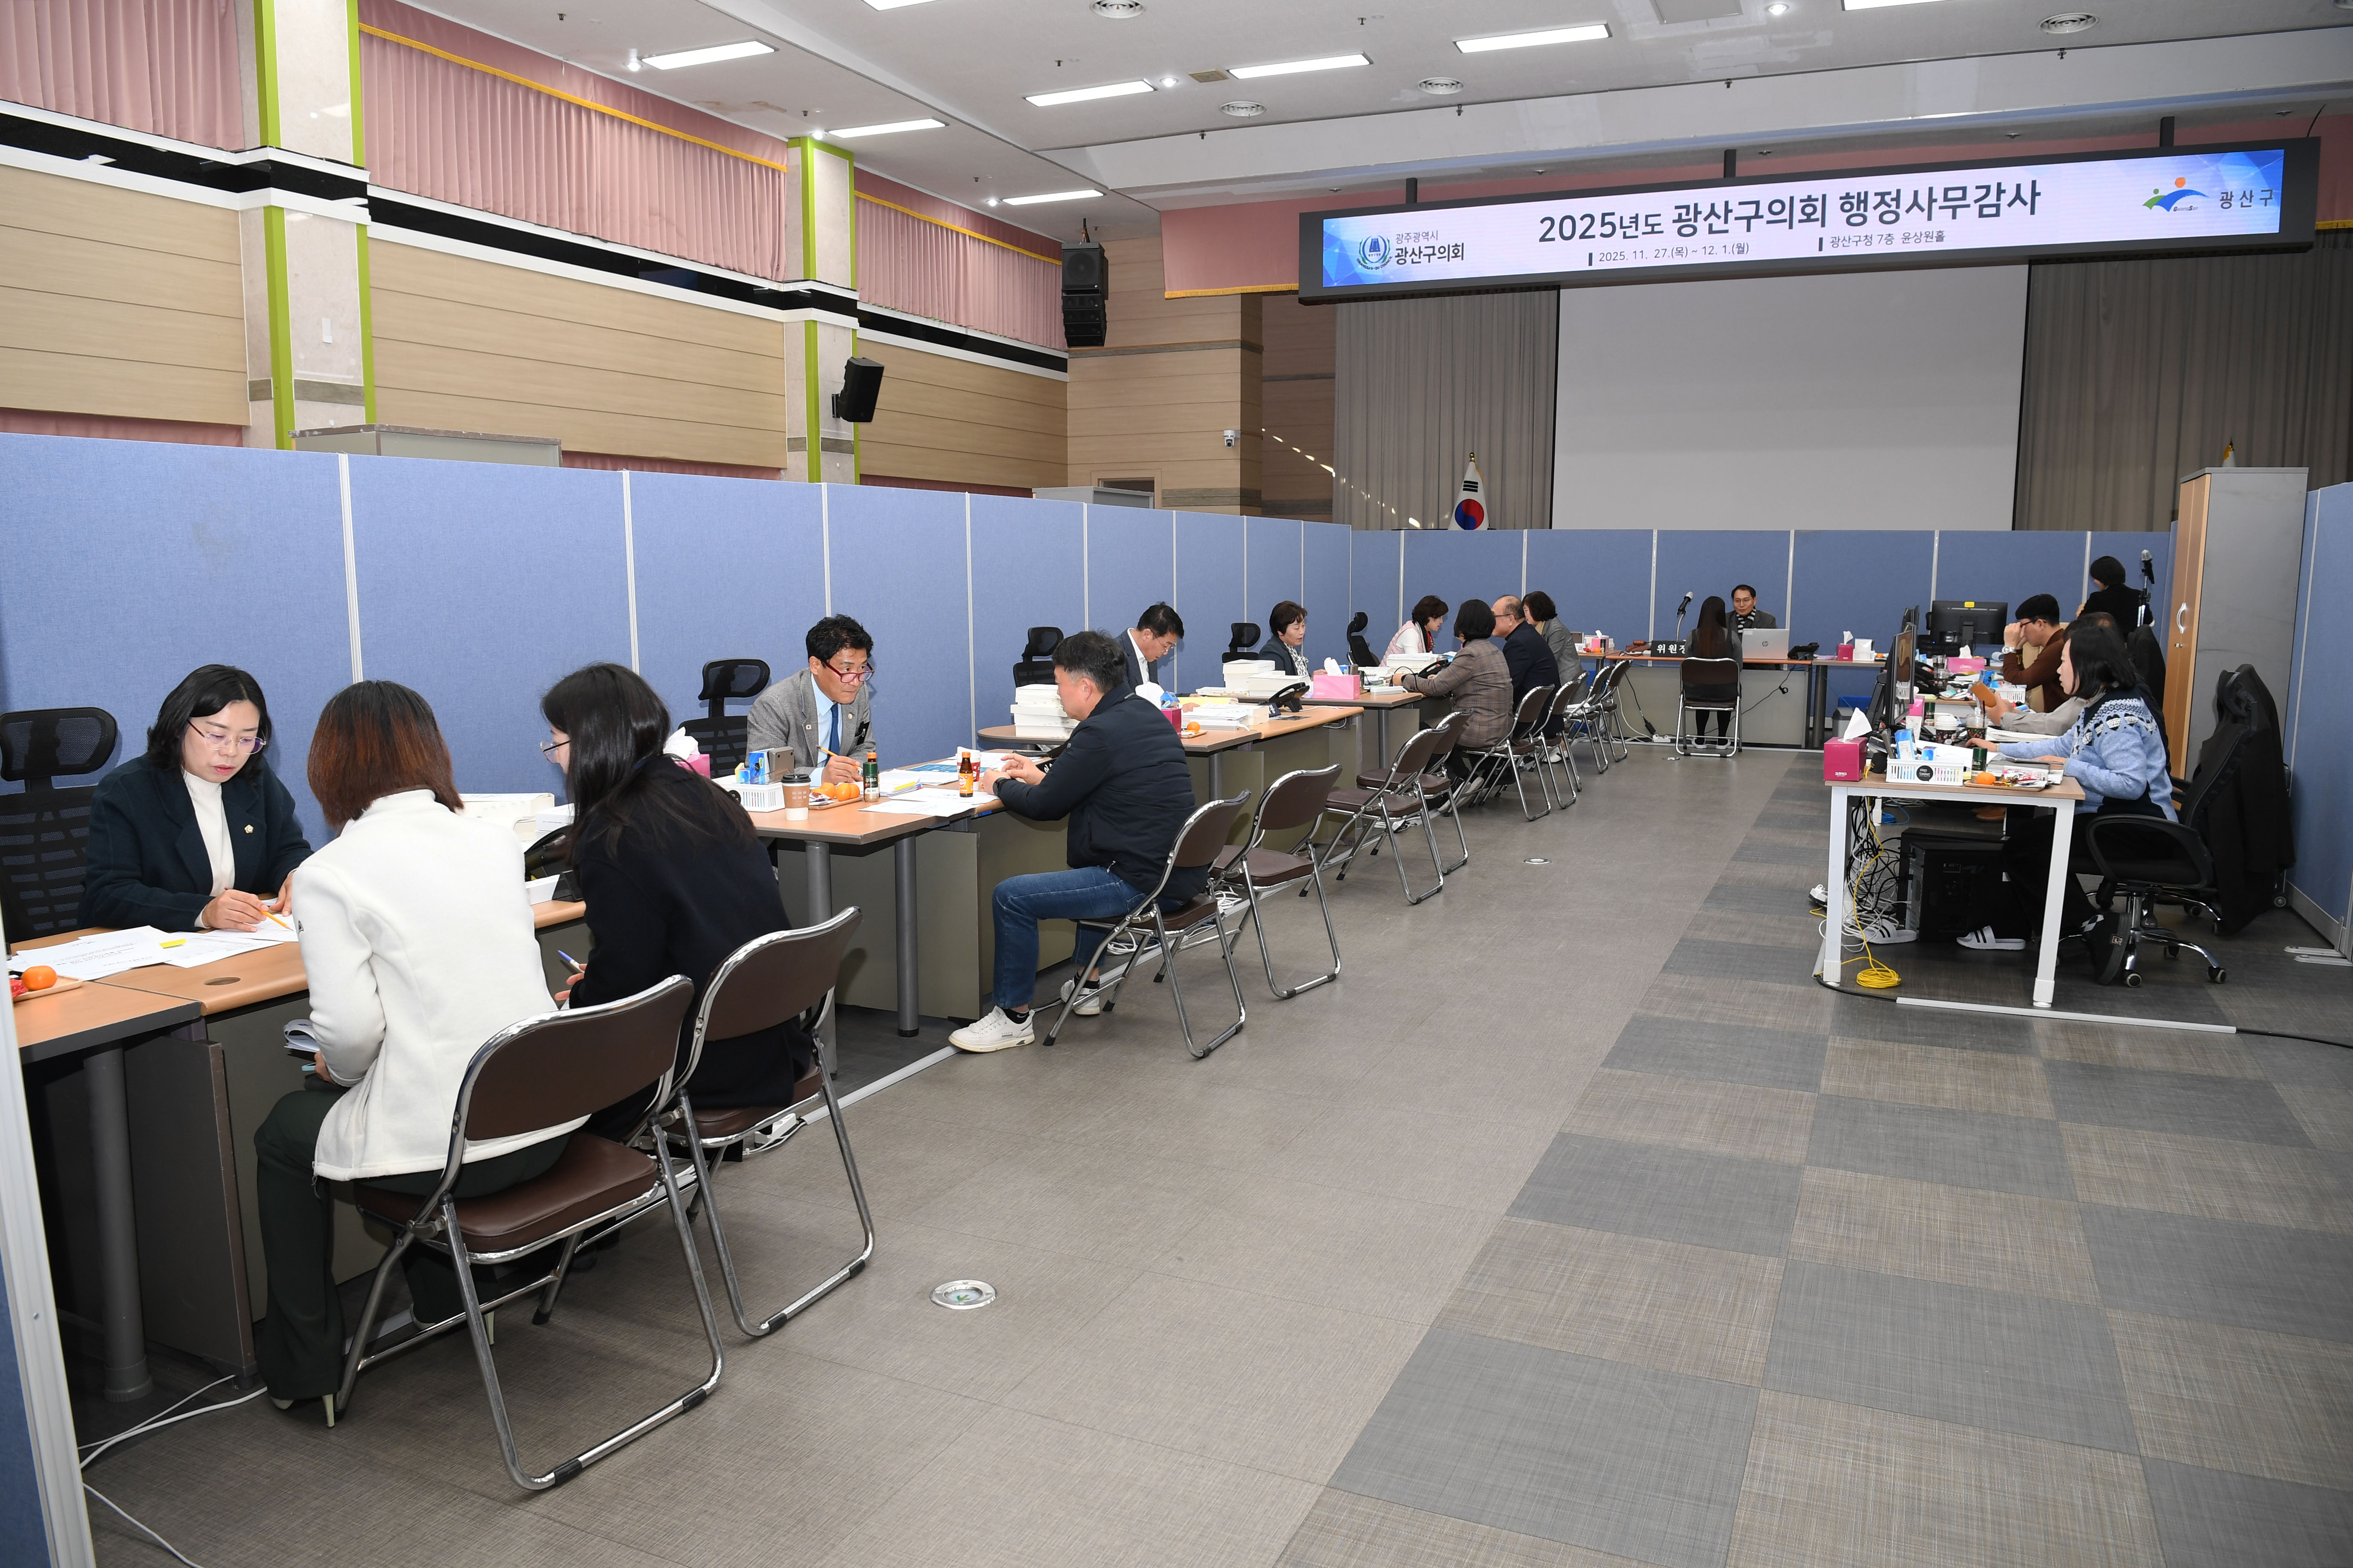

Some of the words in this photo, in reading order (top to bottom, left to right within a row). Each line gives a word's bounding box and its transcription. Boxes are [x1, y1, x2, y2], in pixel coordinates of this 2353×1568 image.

[2220, 188, 2274, 209] 광산구
[1539, 212, 1664, 242] 2025년도
[1672, 194, 1827, 237] 광산구의회
[1839, 179, 2041, 227] 행정사무감사
[1396, 230, 1438, 244] 광주광역시
[1830, 234, 1873, 248] 광산구청
[1877, 233, 1894, 245] 7층
[1901, 230, 1946, 244] 윤상원홀
[1394, 242, 1464, 265] 광산구의회
[1599, 251, 1628, 262] 2025.
[1632, 250, 1648, 259] 11.
[1654, 246, 1688, 259] 27.(목)
[1702, 245, 1718, 255] 12.
[1722, 242, 1749, 255] 1.(월)
